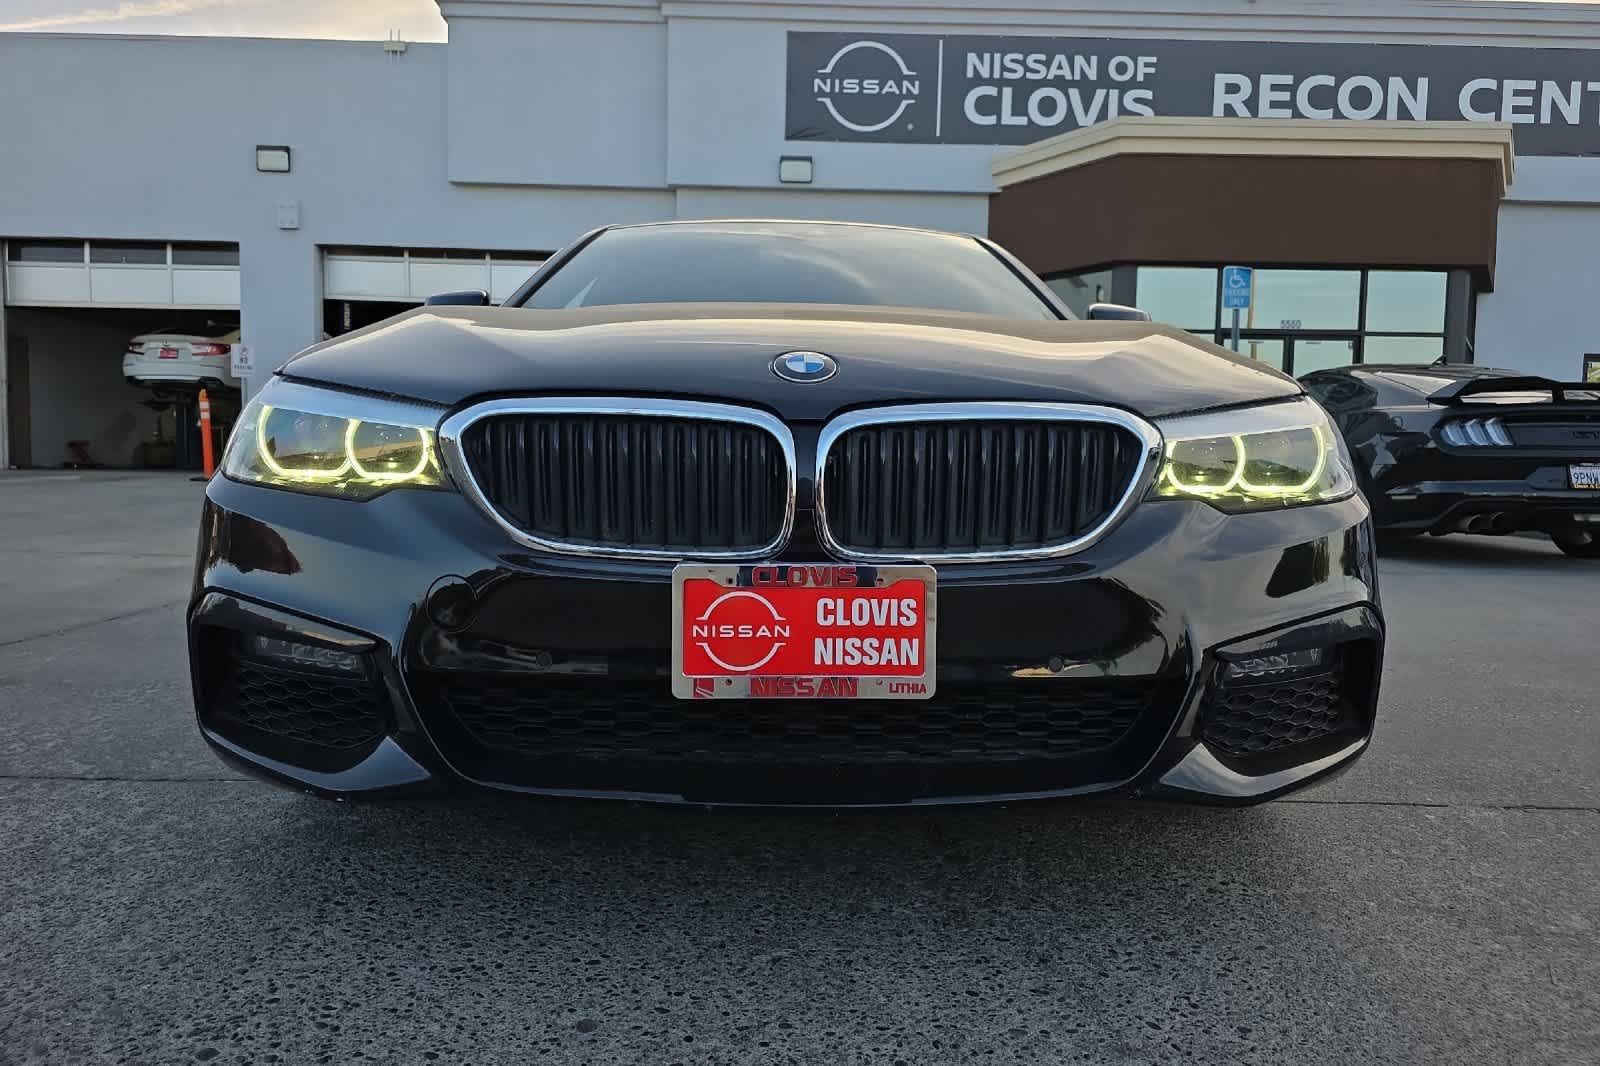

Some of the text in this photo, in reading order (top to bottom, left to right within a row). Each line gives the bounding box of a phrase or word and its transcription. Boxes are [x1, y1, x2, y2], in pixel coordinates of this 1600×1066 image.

[966, 53, 1157, 81] NISSAN OF
[813, 78, 919, 95] NISSAN
[1212, 73, 1429, 120] RECON
[963, 86, 1155, 126] CLOVIS
[752, 566, 858, 587] CLOVIS
[816, 598, 917, 627] CLOVIS
[692, 625, 790, 638] NISSAN
[814, 638, 919, 666] NISSAN
[750, 677, 859, 698] NISSAN
[889, 682, 927, 694] LITHIA
